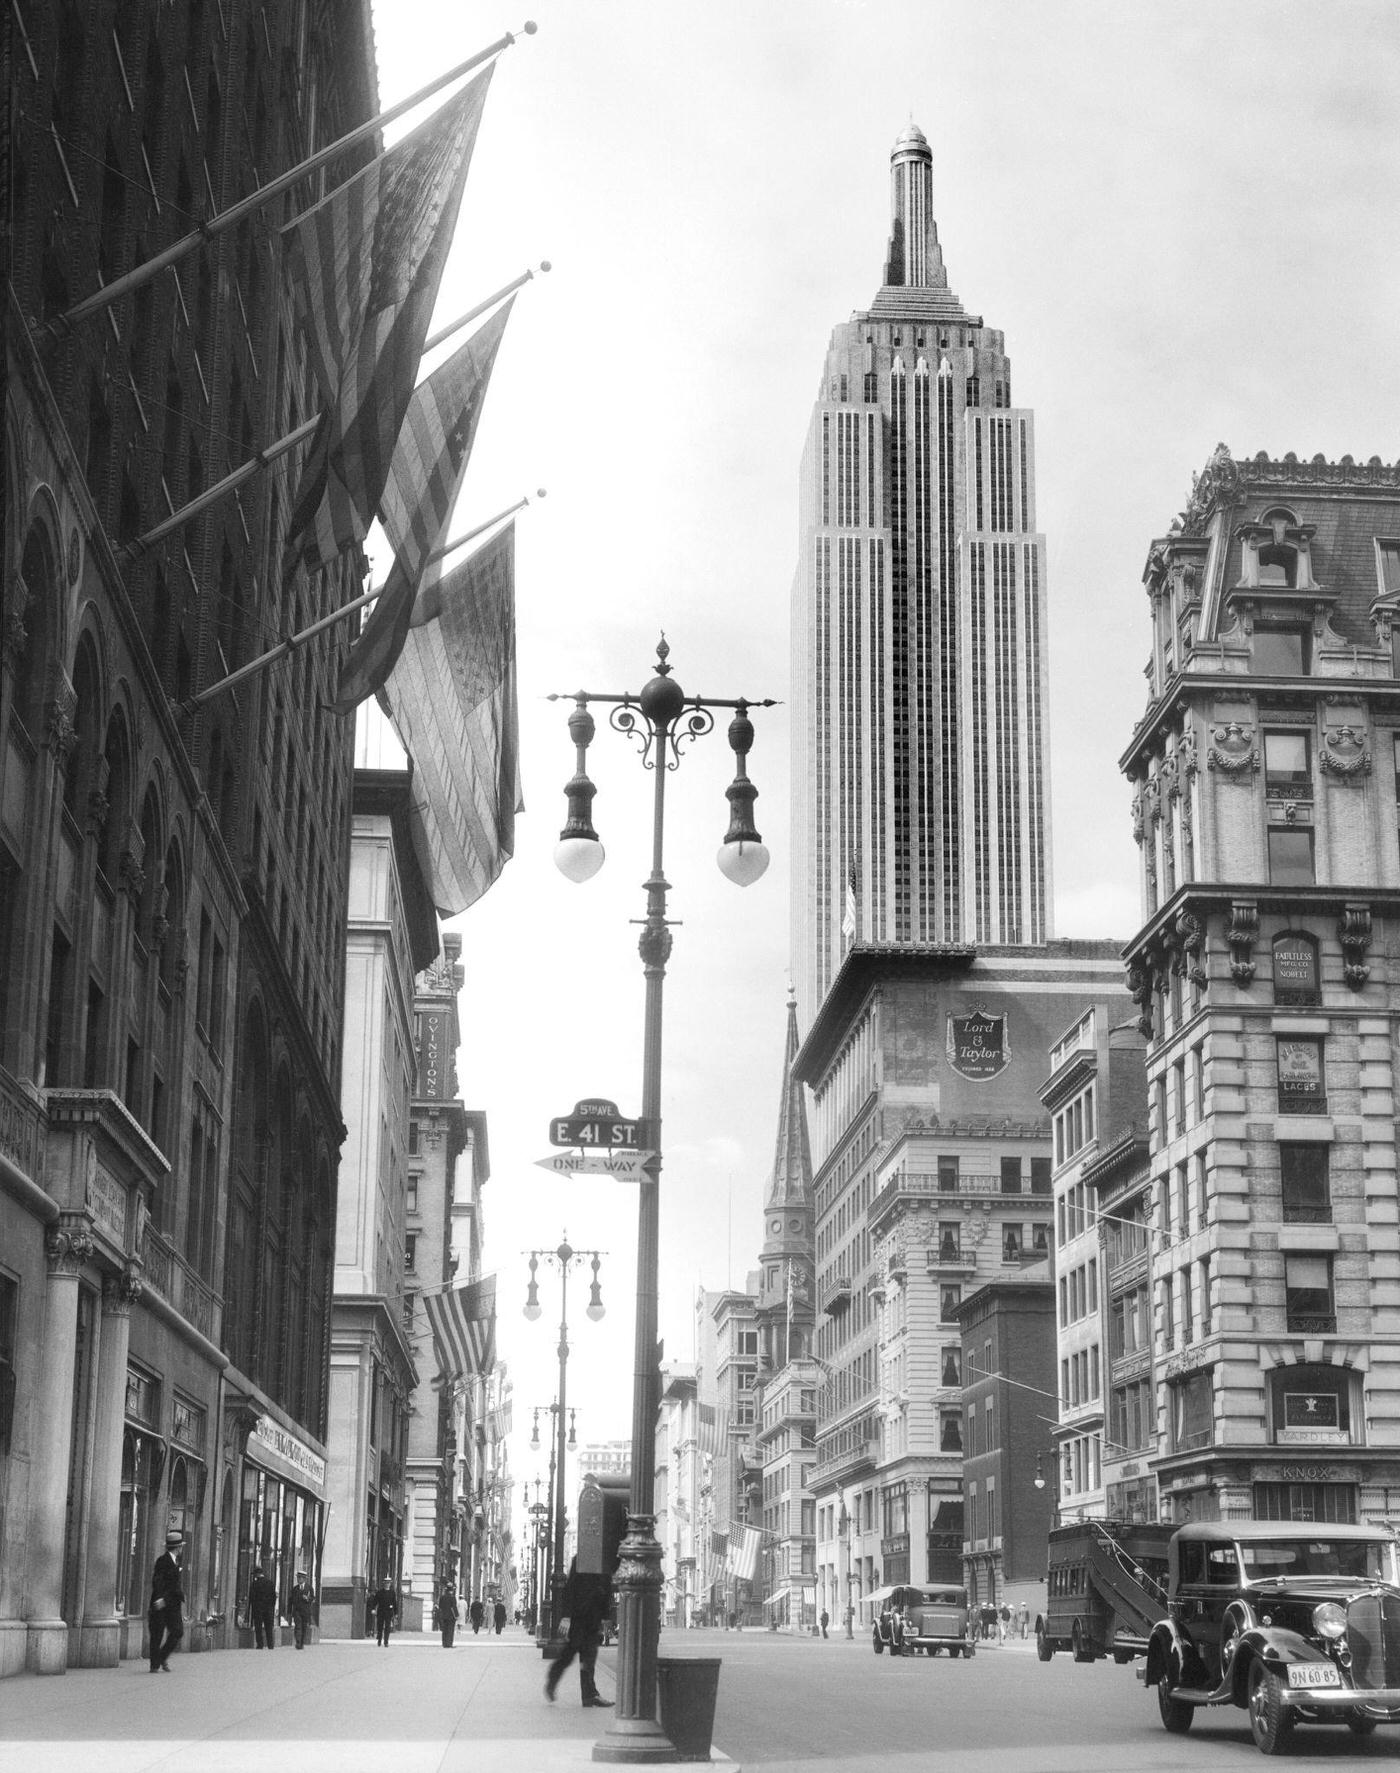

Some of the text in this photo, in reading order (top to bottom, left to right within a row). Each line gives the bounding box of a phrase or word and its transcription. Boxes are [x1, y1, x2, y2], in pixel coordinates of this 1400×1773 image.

[1275, 952, 1312, 960] FAULTLESS
[963, 1022, 994, 1032] Lord
[972, 1035, 983, 1046] &
[960, 1046, 1000, 1062] Taylor
[1283, 1082, 1316, 1091] LACES
[580, 1104, 597, 1115] 5TH
[557, 1122, 637, 1143] E. 41 ST.
[553, 1158, 584, 1171] ONE
[603, 1160, 636, 1172] WAY
[1281, 1431, 1345, 1441] YARDLEY
[1283, 1466, 1329, 1478] KNOX
